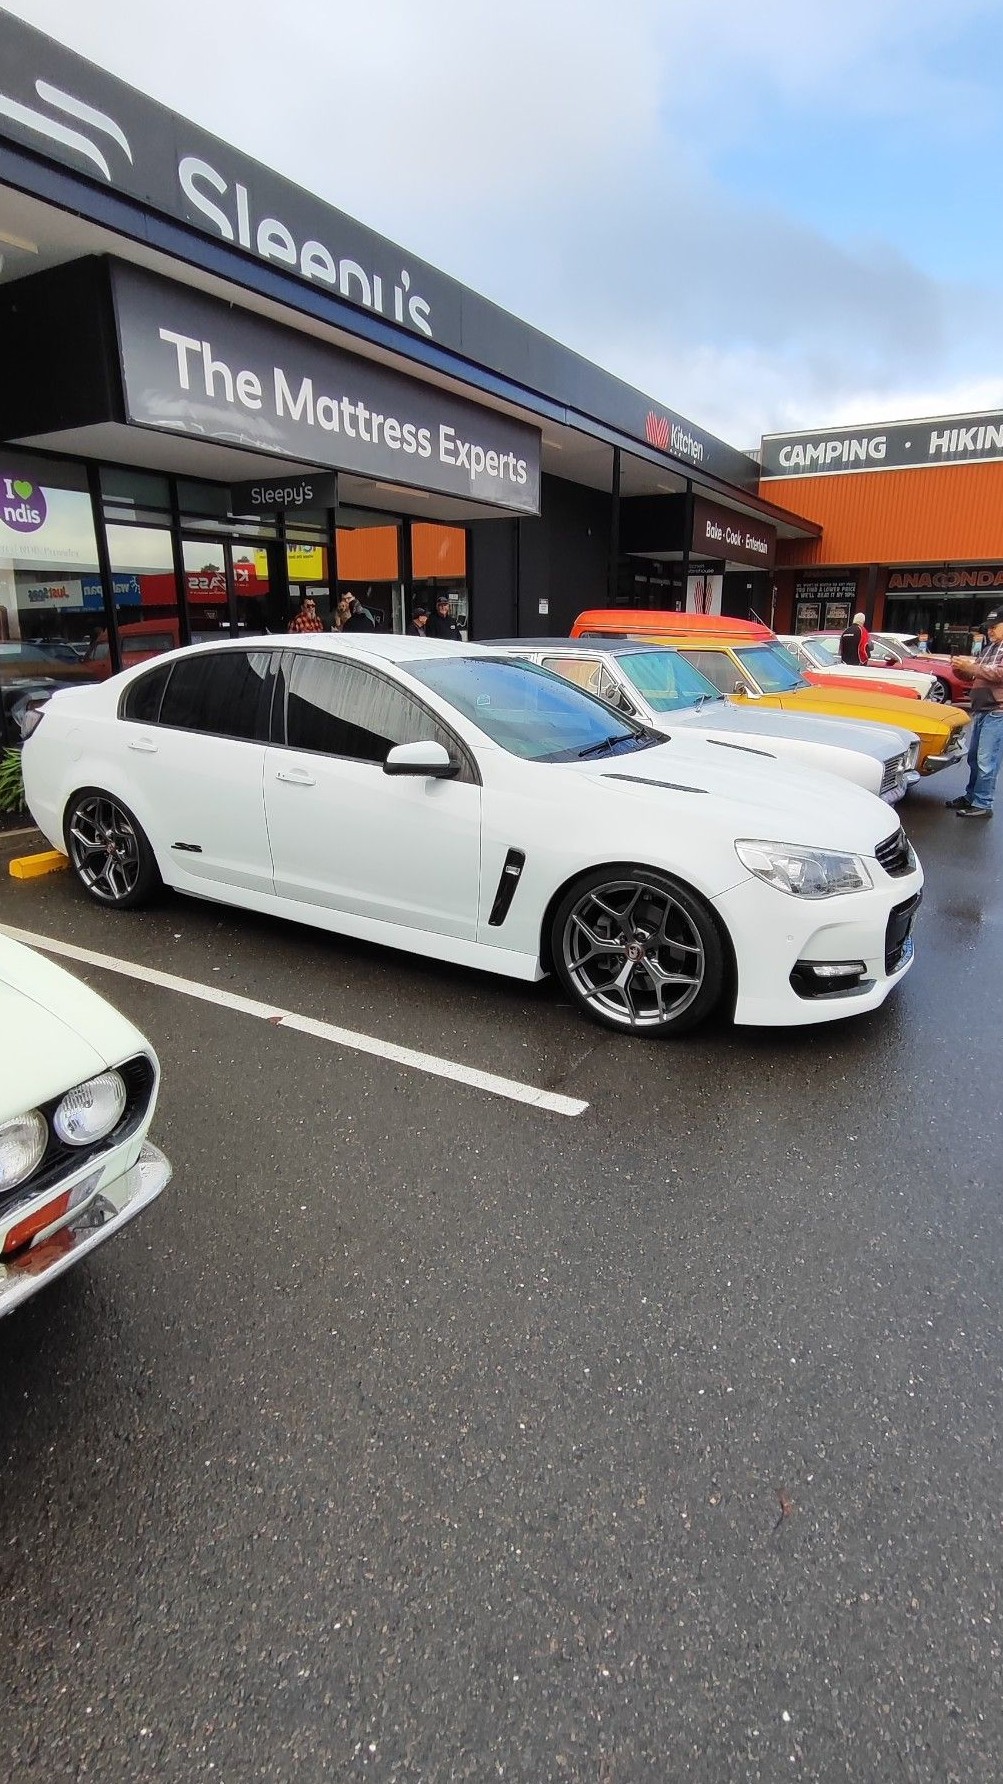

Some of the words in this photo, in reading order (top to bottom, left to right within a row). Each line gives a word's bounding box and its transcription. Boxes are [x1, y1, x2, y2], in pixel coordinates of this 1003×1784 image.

[159, 327, 263, 410] The
[274, 366, 433, 458] Mattress
[438, 424, 528, 485] Experts
[671, 423, 704, 462] Kitchen
[778, 435, 887, 468] CAMPING
[3, 478, 15, 499] I
[251, 481, 314, 506] Sleepy's
[3, 503, 41, 524] ndis
[706, 520, 722, 540] Bake
[725, 527, 742, 546] Cook
[745, 534, 768, 554] Entertain
[888, 570, 1003, 589] ANACONDA
